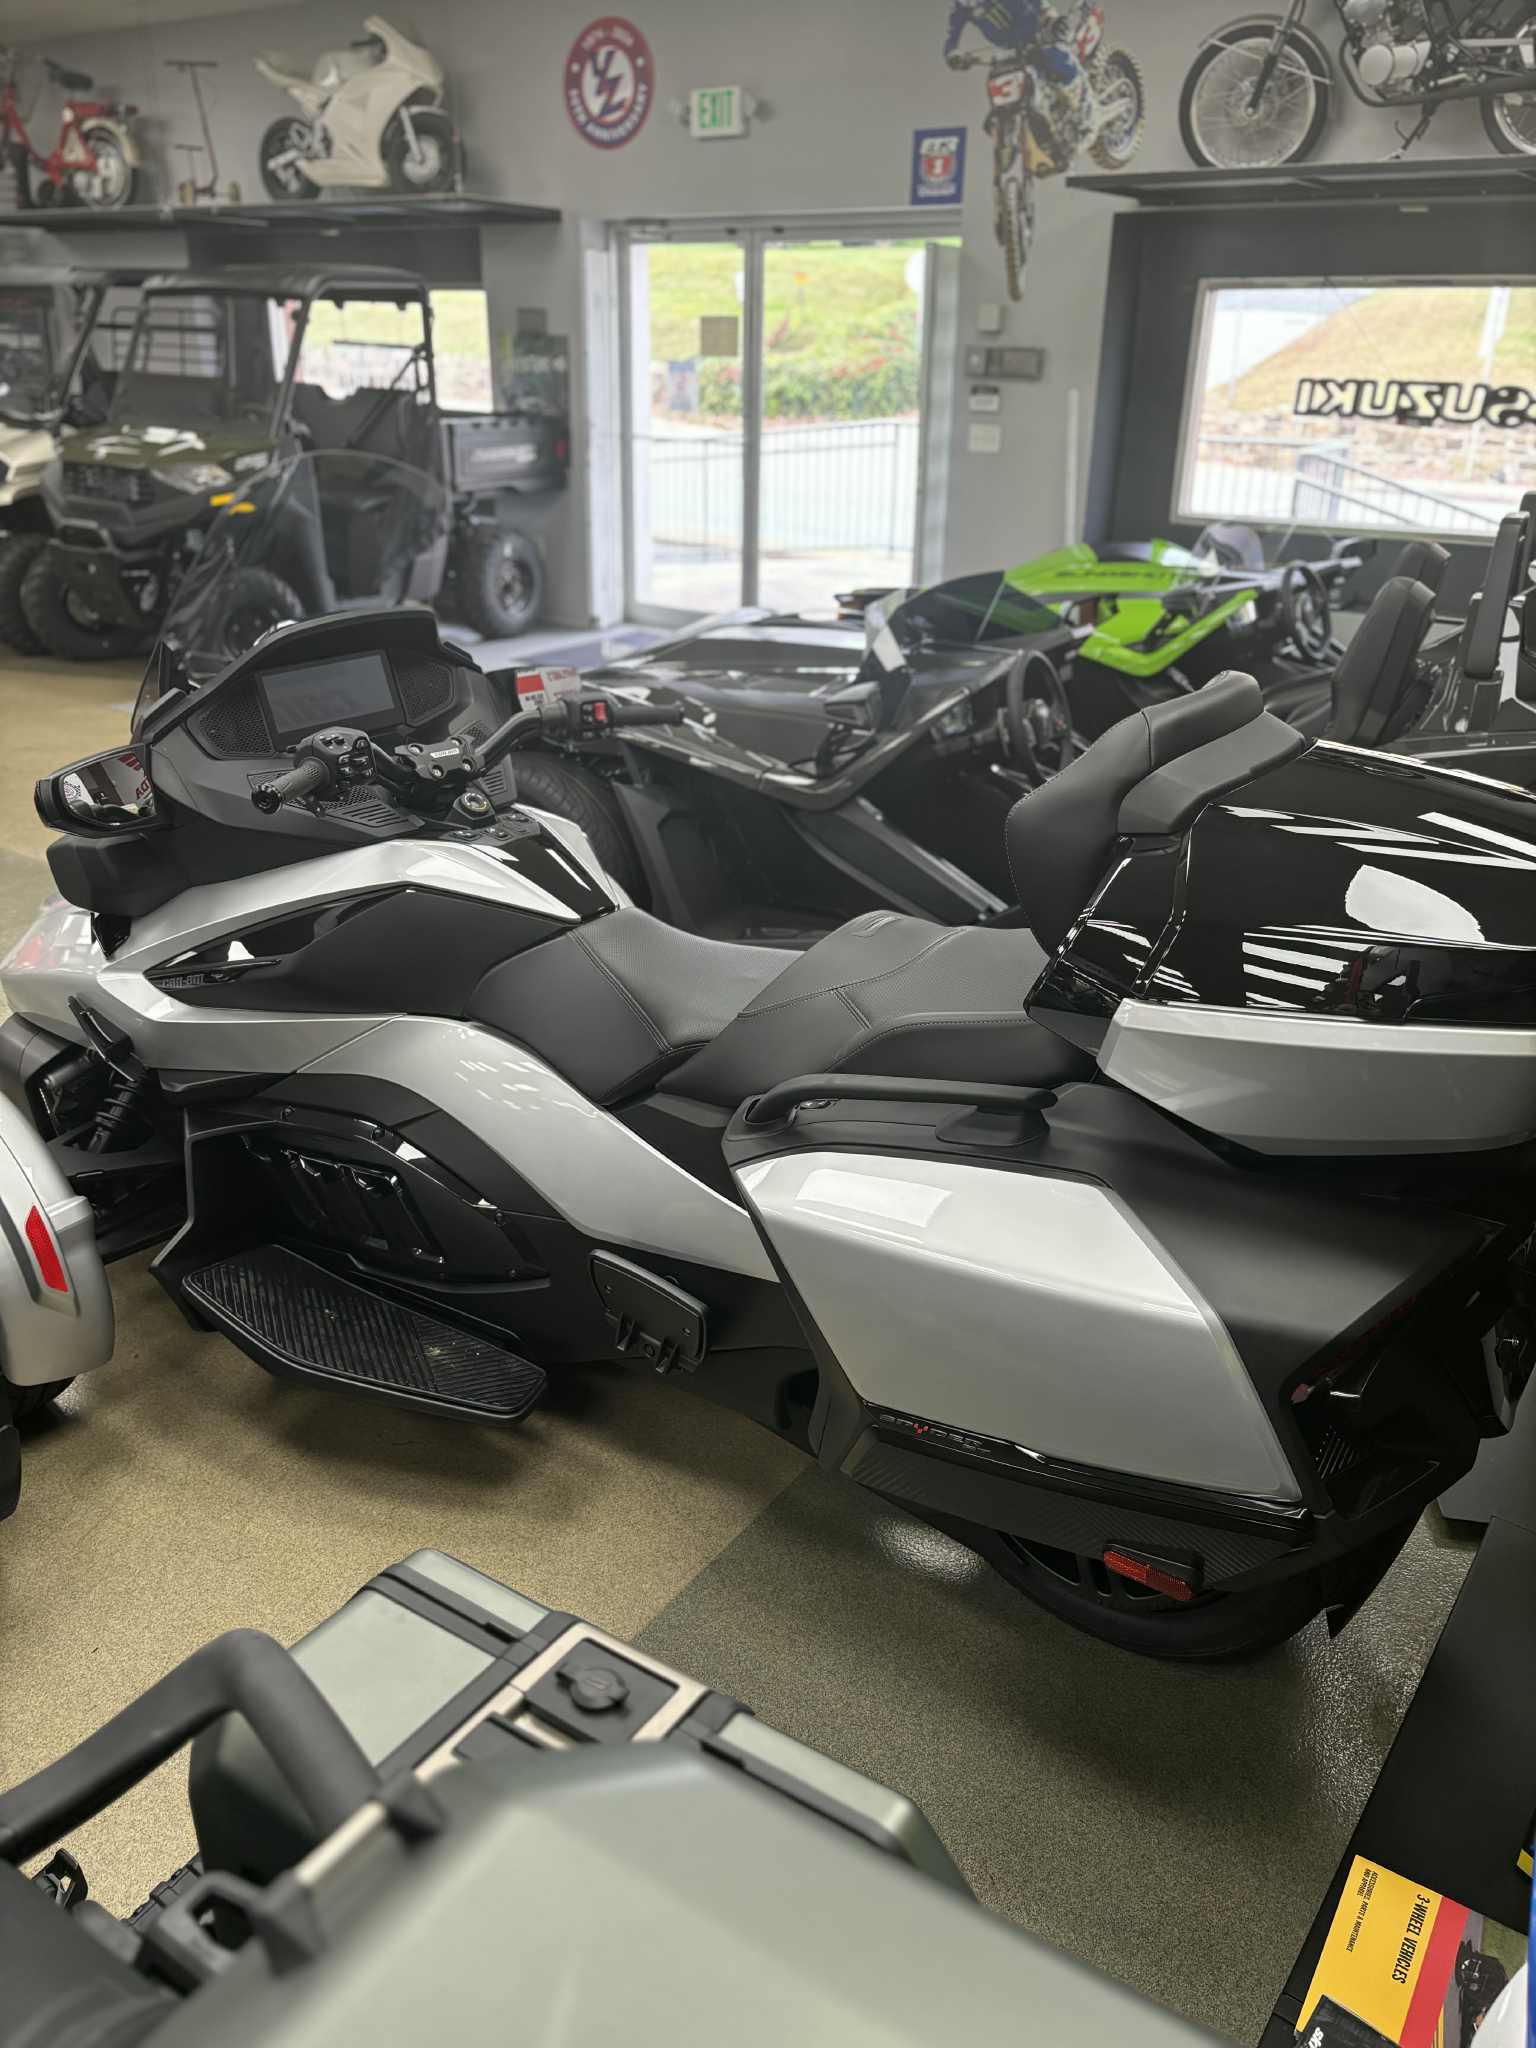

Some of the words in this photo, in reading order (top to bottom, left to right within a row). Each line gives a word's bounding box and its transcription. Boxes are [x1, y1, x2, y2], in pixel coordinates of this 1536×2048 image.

[698, 90, 735, 129] EXIT
[1406, 1894, 1431, 1936] 3-WHEEL
[1346, 1919, 1362, 1952] MAINTENANCE
[1391, 1936, 1418, 1984] VEHICLES
